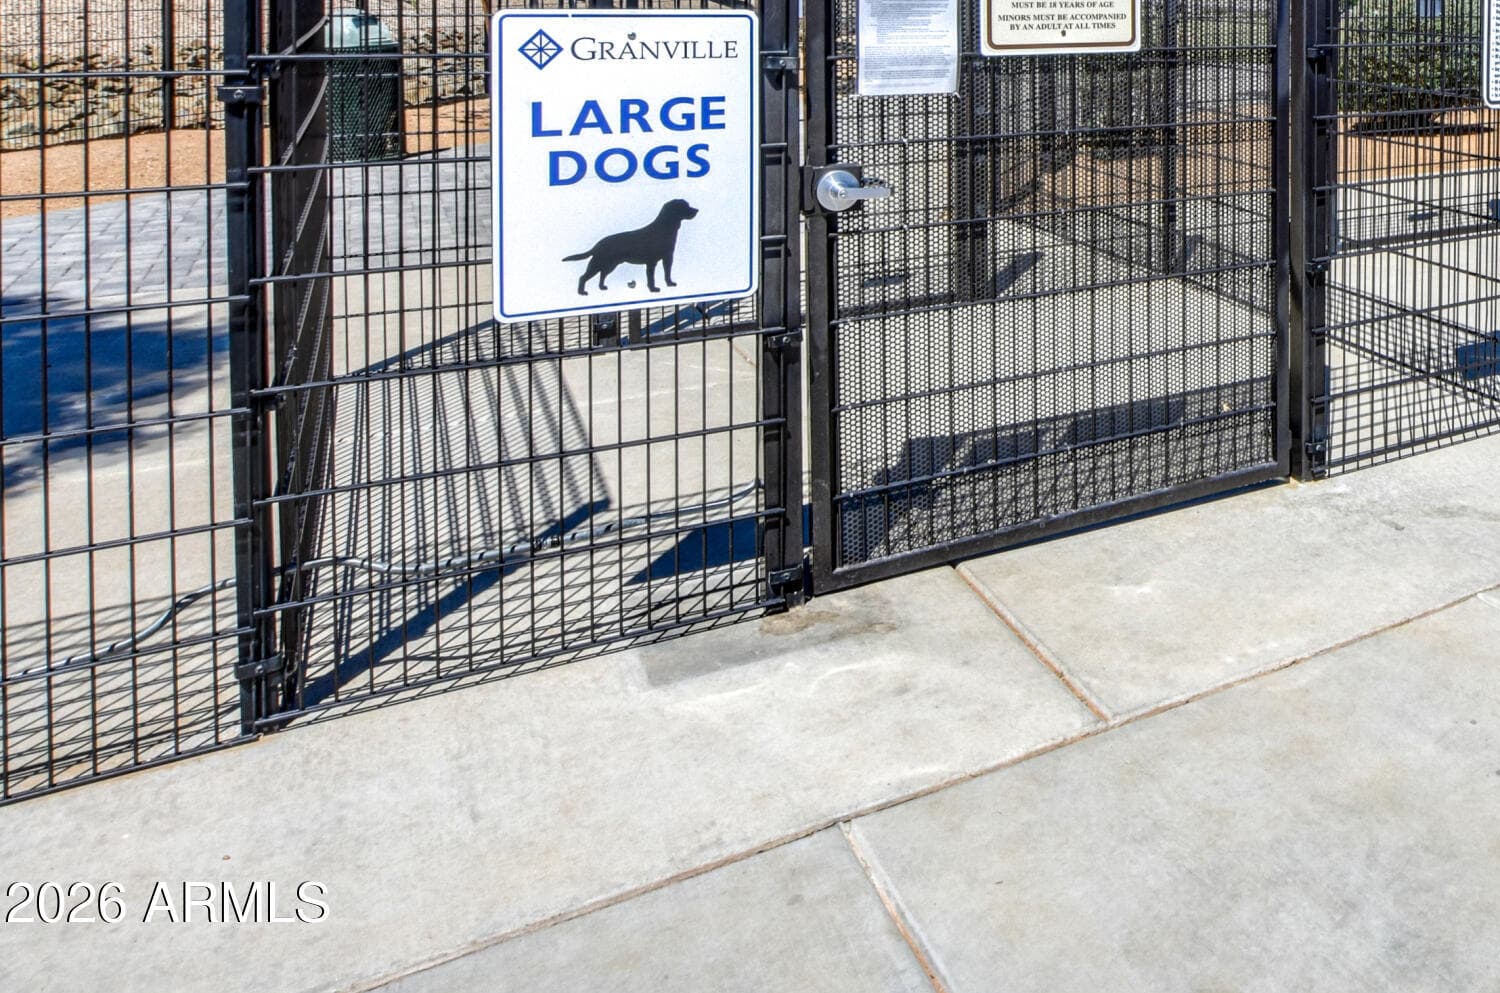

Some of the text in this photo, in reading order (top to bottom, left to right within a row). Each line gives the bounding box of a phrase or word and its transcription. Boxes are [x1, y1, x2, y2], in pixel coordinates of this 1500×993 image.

[570, 37, 738, 61] GRANVILLE
[531, 96, 726, 138] LARGE
[549, 143, 710, 186] DOGS
